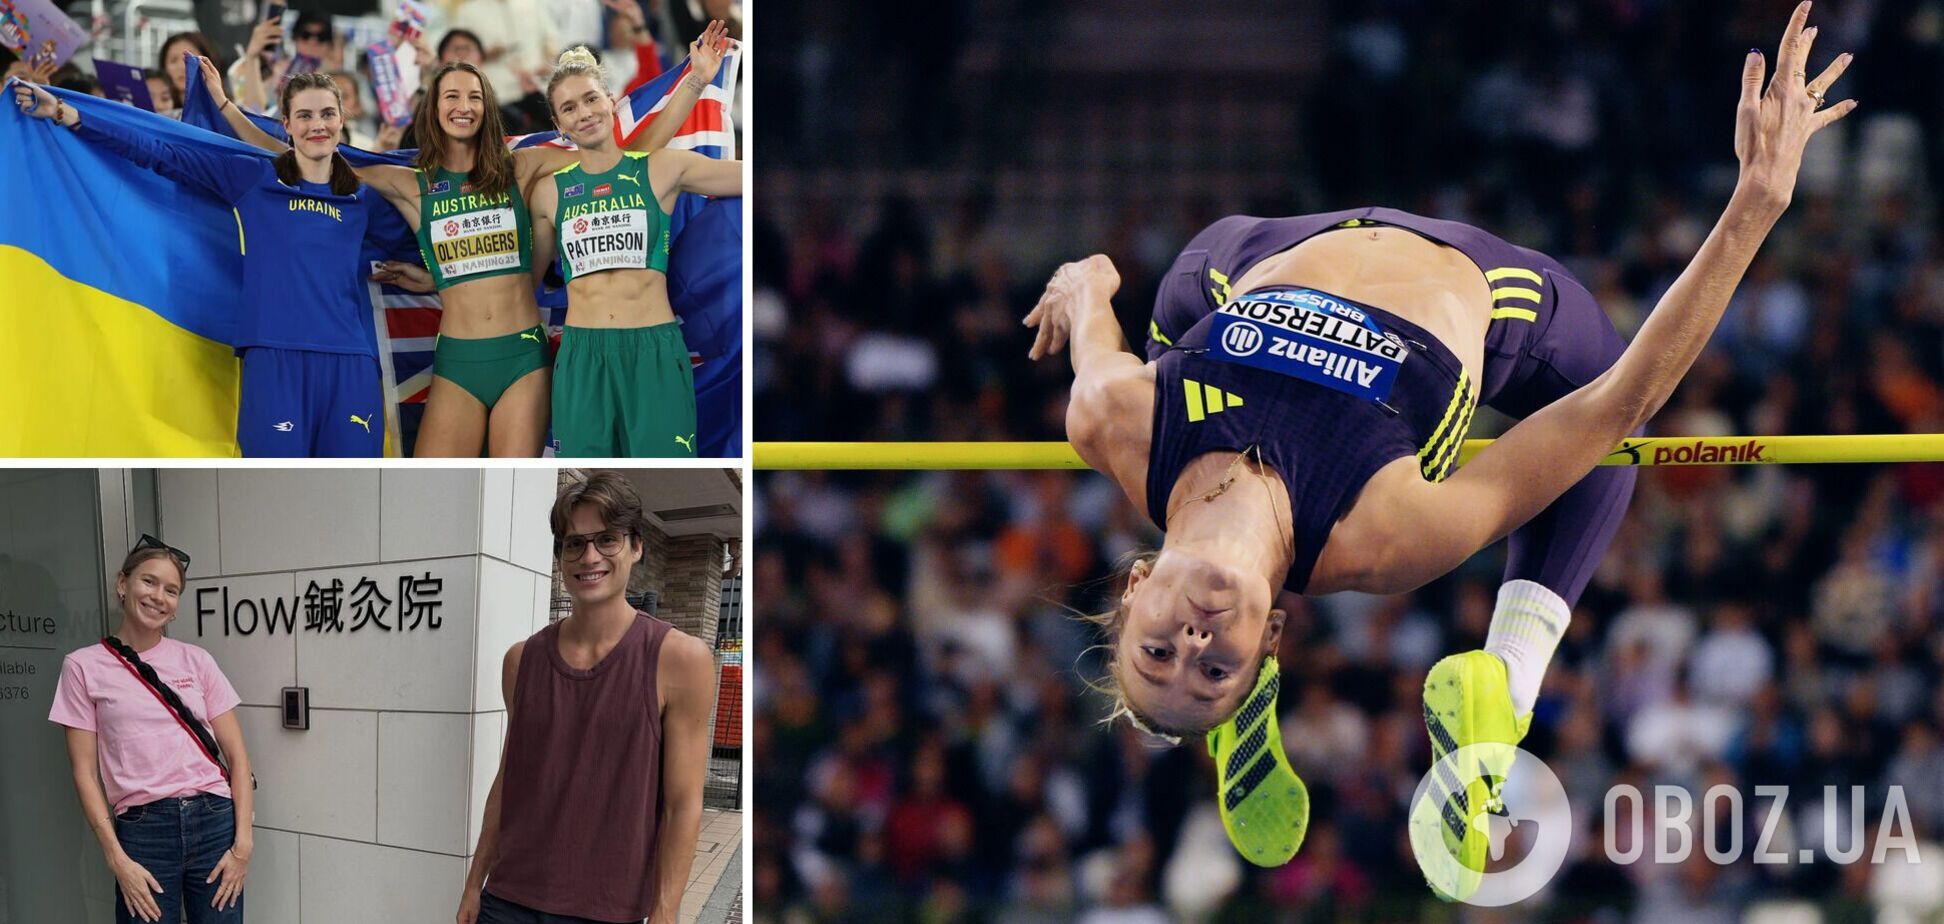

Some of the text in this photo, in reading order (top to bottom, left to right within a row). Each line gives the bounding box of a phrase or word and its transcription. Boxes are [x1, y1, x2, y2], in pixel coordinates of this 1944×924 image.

[289, 198, 342, 222] UKRAINE
[563, 193, 646, 220] AUSTRALIA
[438, 232, 515, 262] OLYSLAGERS
[566, 232, 643, 260] PATTERSON
[1254, 292, 1366, 323] BRUSSELS
[1225, 301, 1401, 360] PATTERSON
[1268, 336, 1383, 389] Allianz
[1653, 440, 1766, 465] polanik
